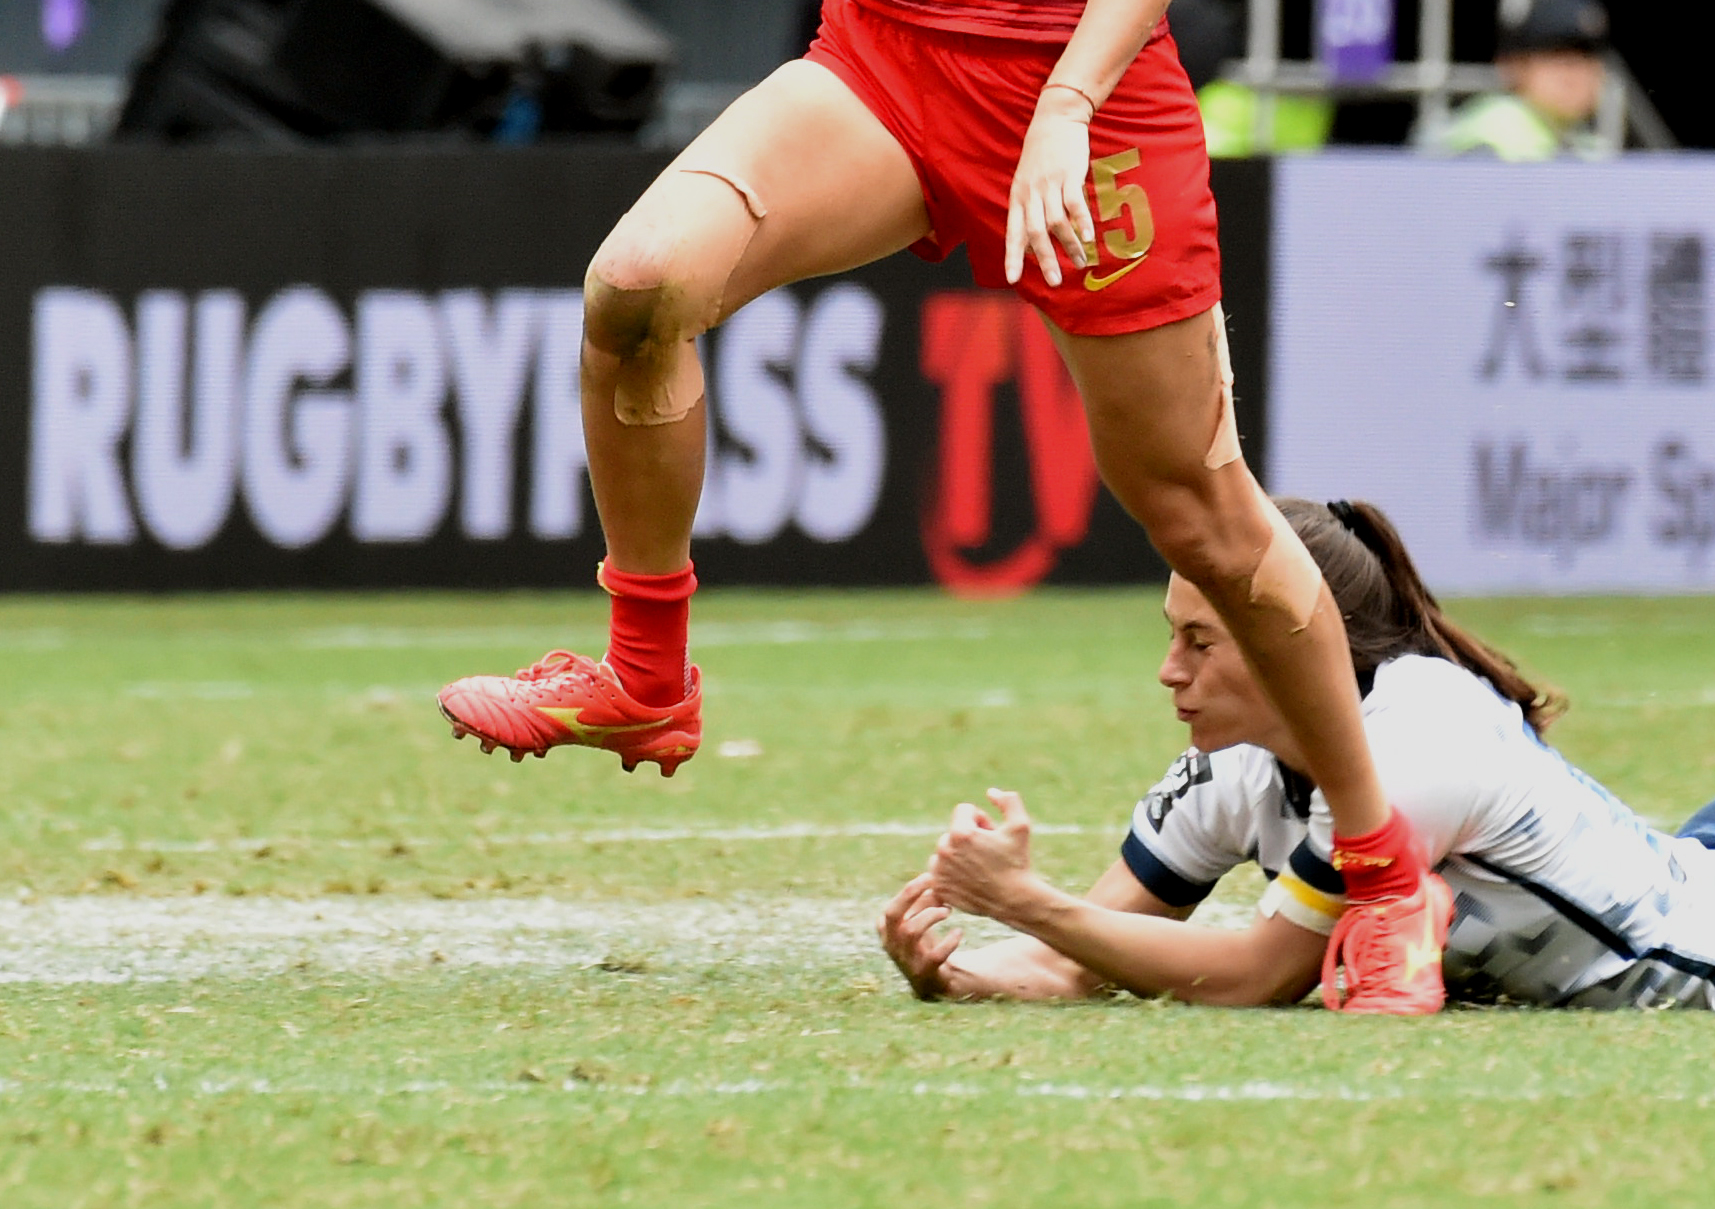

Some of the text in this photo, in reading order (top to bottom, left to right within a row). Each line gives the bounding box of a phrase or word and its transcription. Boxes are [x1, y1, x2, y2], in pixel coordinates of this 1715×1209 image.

[1080, 147, 1155, 267] 5
[28, 282, 885, 549] RUGBYPSS
[1470, 435, 1634, 565] Major
